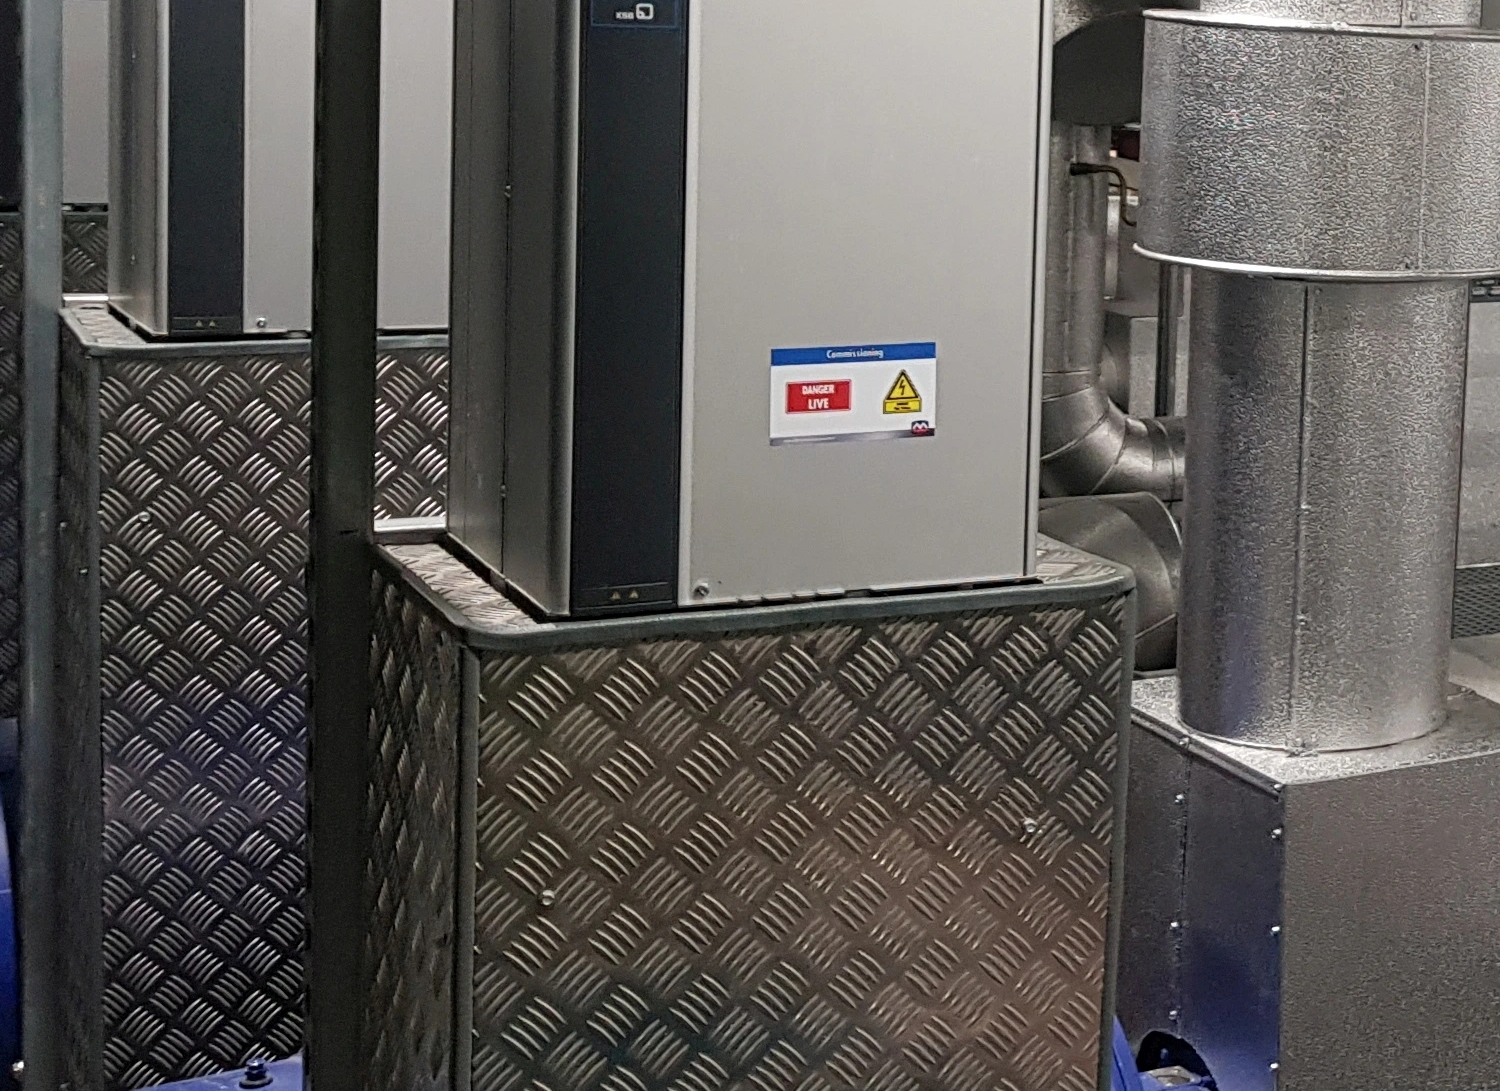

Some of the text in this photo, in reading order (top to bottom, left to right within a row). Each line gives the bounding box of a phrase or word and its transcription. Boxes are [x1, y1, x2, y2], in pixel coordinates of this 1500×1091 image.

[826, 348, 884, 359] Commissioning
[802, 384, 835, 395] DANGER
[808, 398, 829, 410] LIVE
